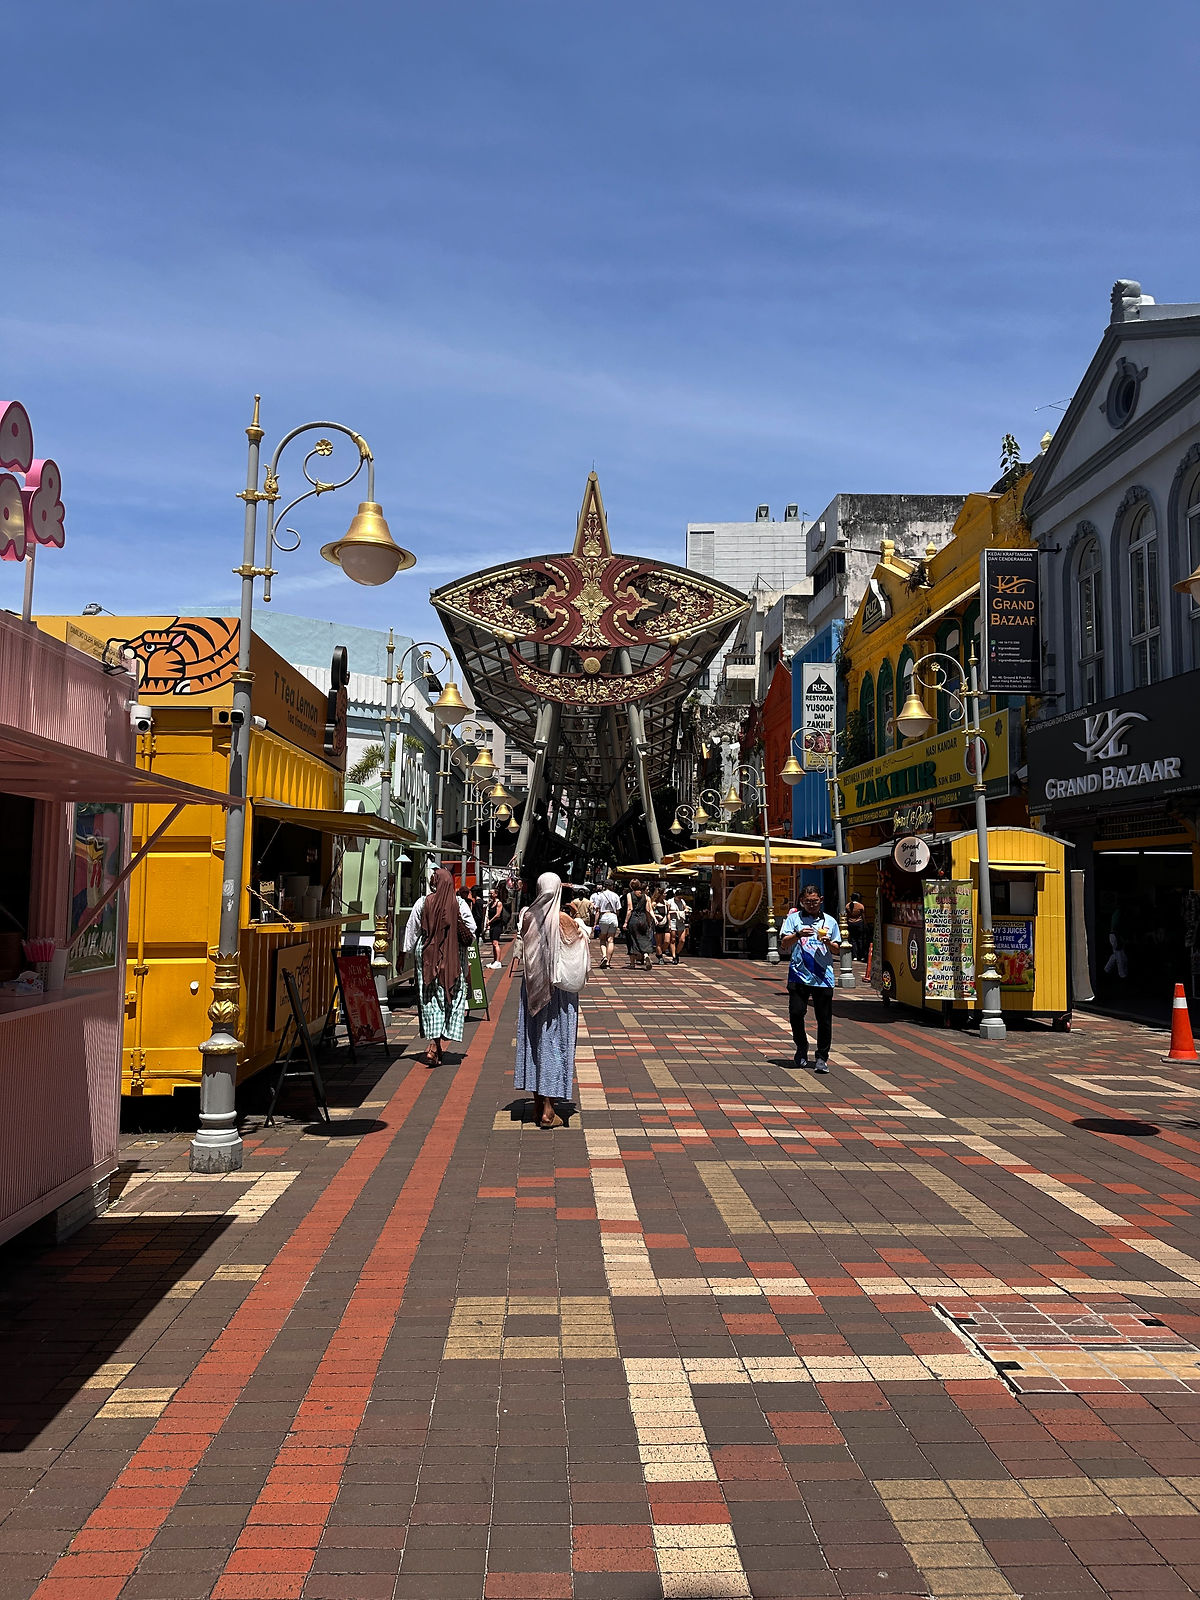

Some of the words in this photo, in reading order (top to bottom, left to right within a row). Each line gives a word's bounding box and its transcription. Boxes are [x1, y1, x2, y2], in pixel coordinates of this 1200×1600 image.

[992, 598, 1035, 610] GRAND
[812, 684, 828, 692] RUZ
[274, 669, 279, 695] T
[280, 676, 295, 707] Tea
[296, 688, 318, 725] Lemon
[806, 704, 834, 712] YUSOOF
[926, 744, 936, 758] NASI
[936, 737, 958, 754] KANDAR
[855, 761, 938, 808] ZAKHIR
[1045, 774, 1101, 800] GRAND
[1102, 757, 1182, 791] BAZAAR
[901, 842, 921, 852] Bread
[904, 858, 922, 868] Juice
